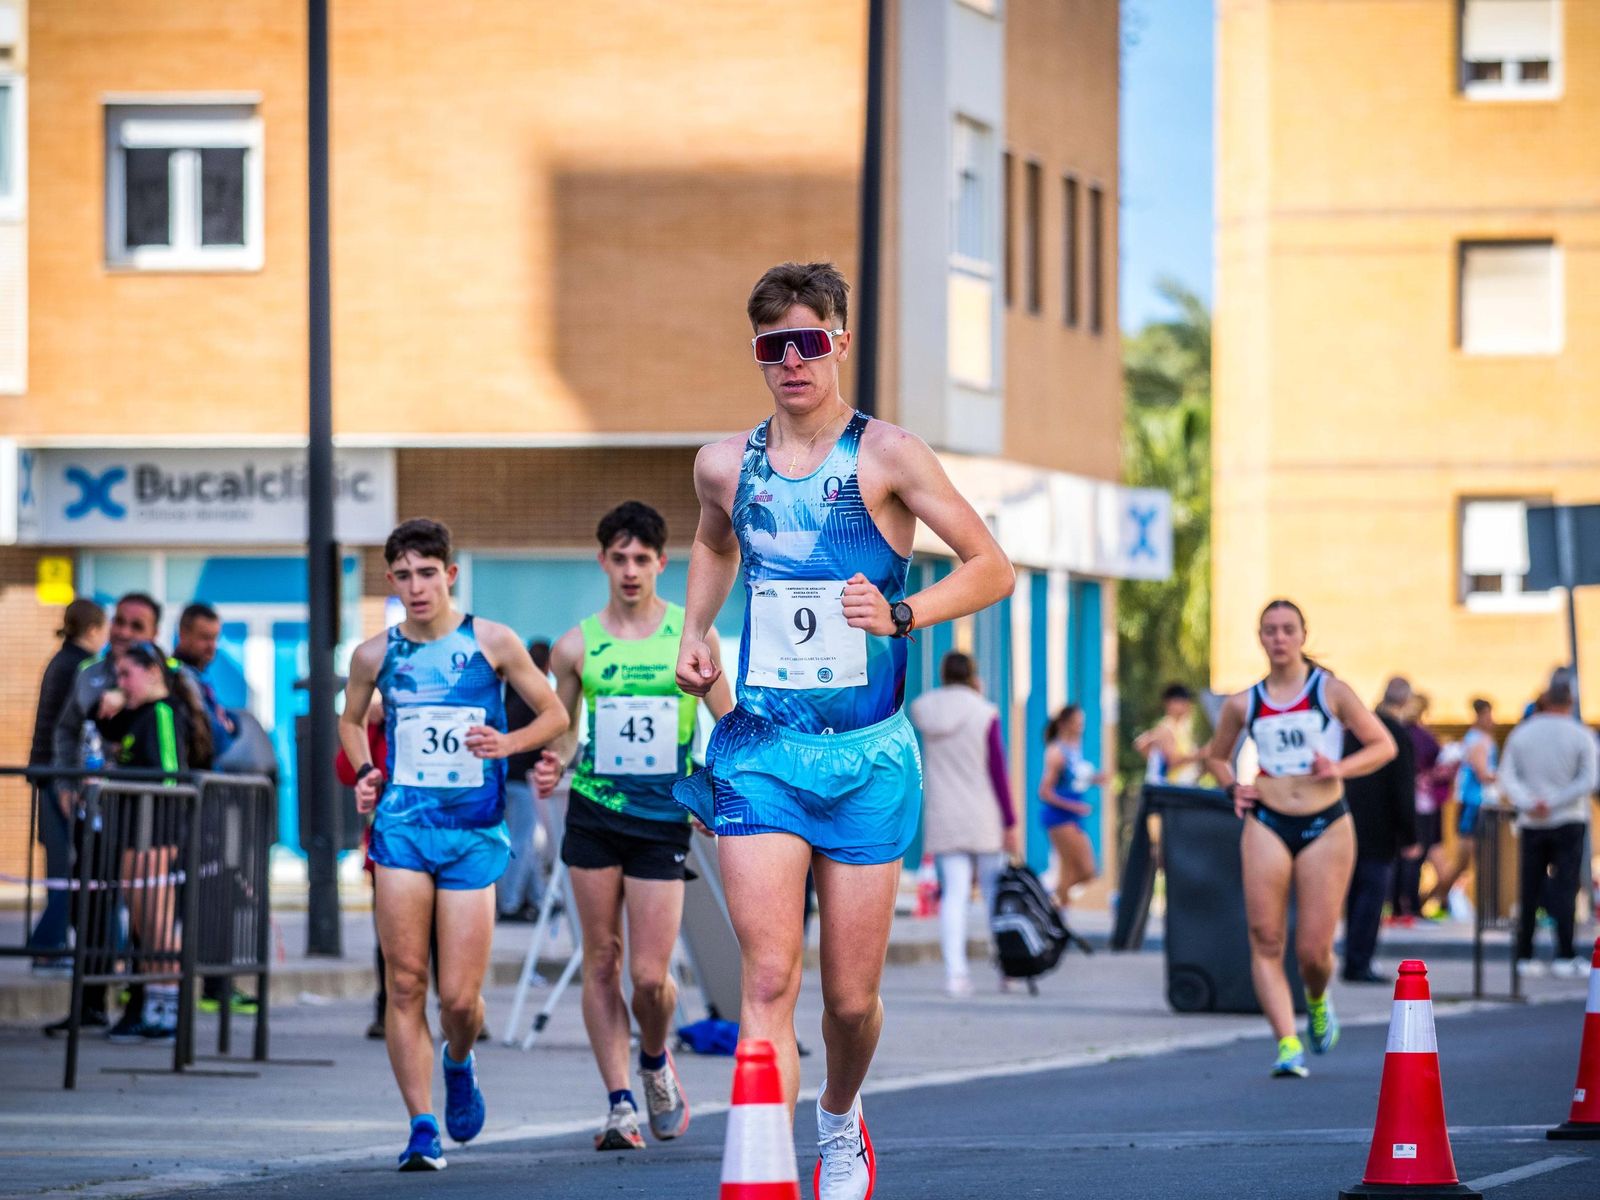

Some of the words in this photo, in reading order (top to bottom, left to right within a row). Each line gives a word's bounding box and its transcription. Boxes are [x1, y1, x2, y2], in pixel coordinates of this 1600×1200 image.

[134, 462, 374, 503] Bucalcliic
[793, 607, 817, 645] 9
[421, 727, 459, 754] 36
[619, 716, 655, 743] 43
[1276, 729, 1305, 752] 30
